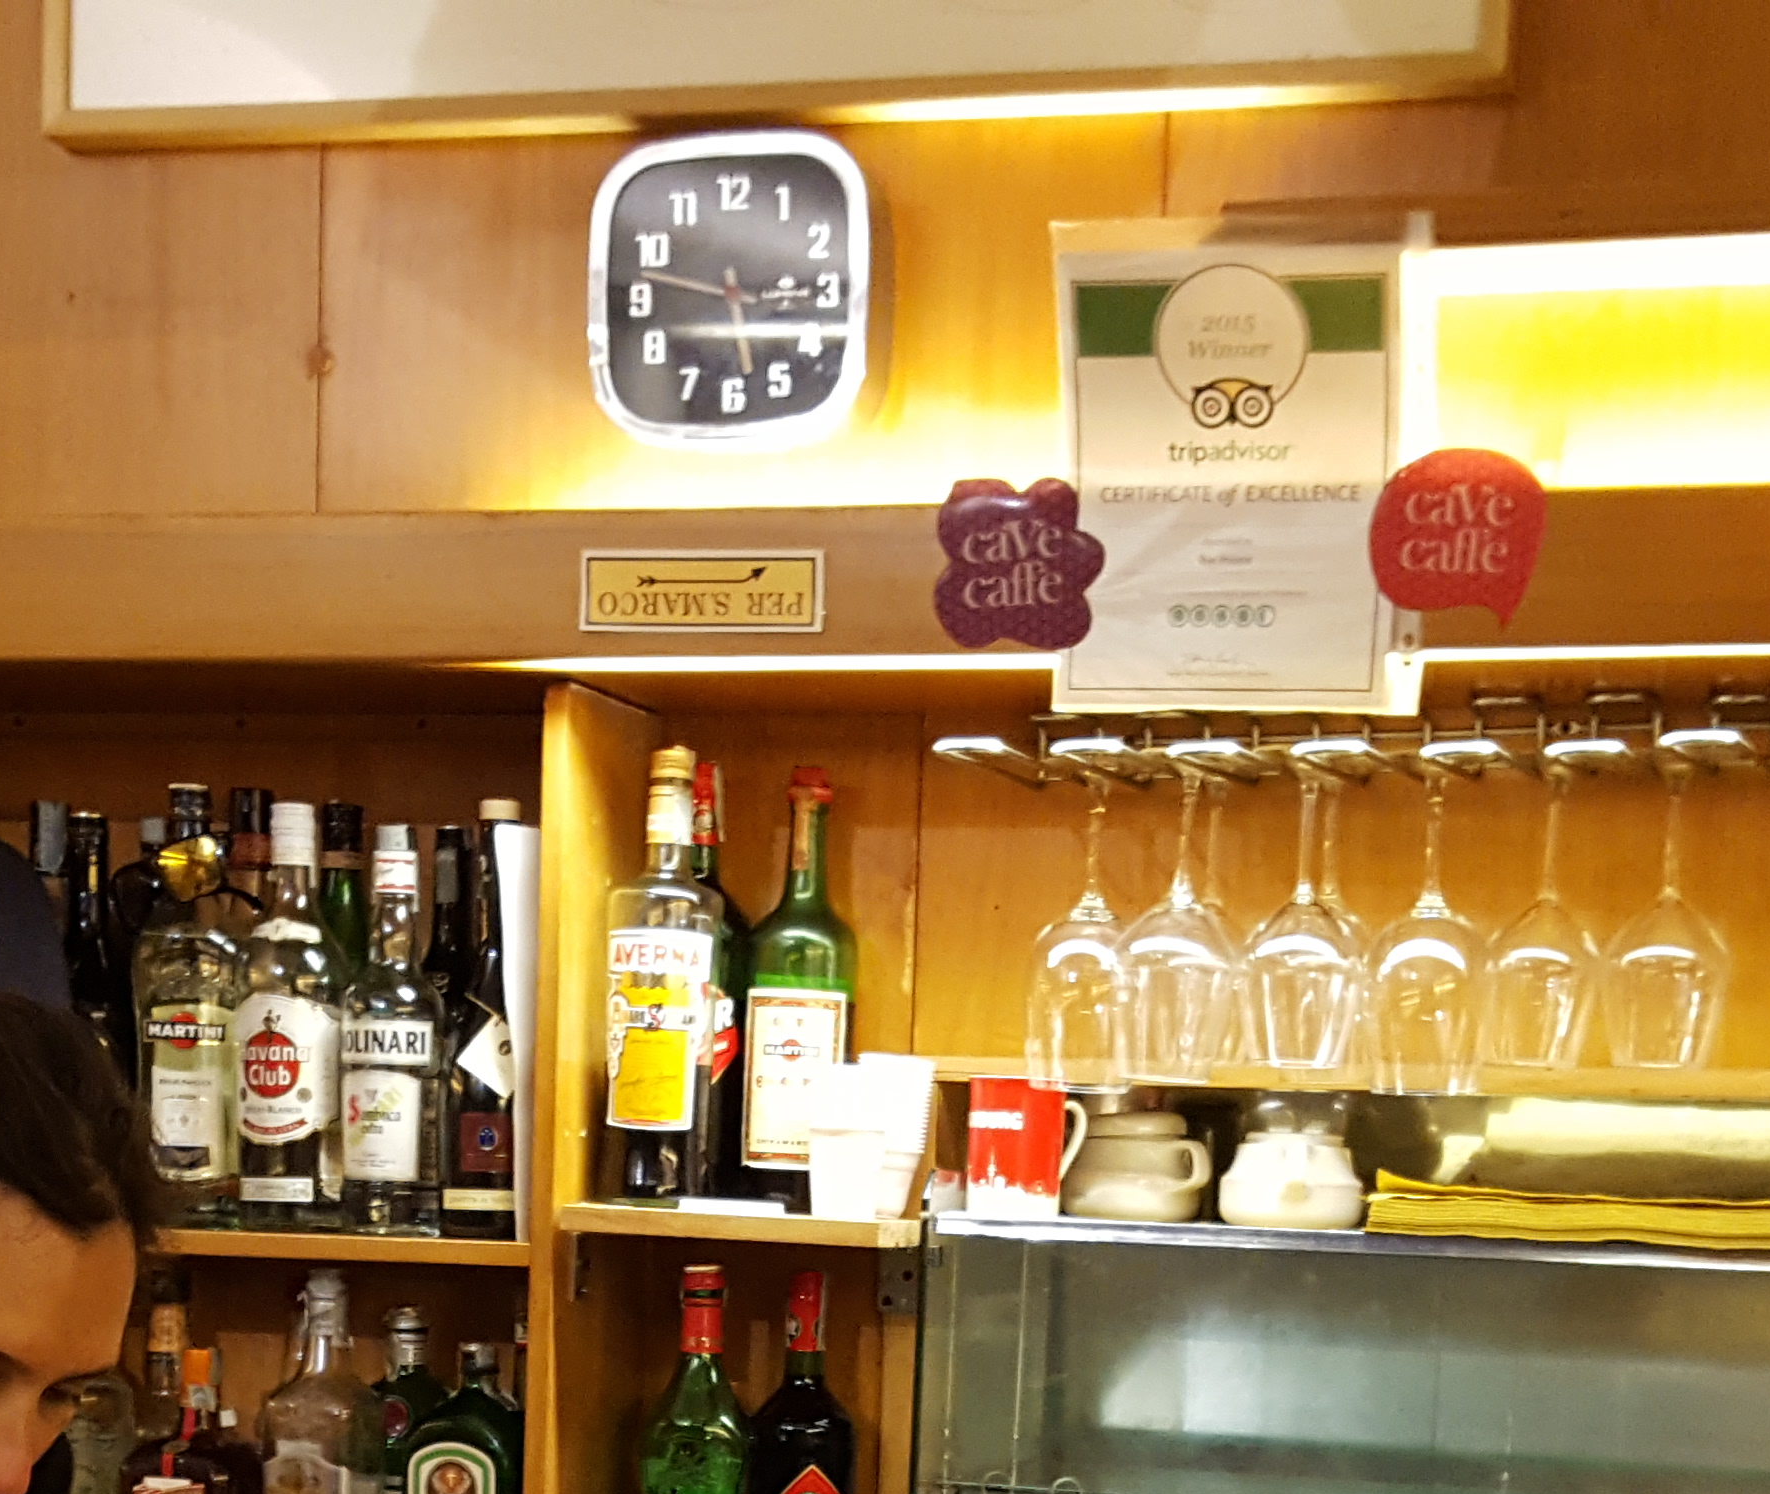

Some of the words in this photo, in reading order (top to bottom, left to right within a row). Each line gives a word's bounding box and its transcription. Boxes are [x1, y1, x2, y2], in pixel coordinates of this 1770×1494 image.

[670, 191, 698, 226] 11
[716, 174, 751, 210] 12
[775, 184, 793, 220] 1
[635, 233, 670, 267] 10
[808, 222, 831, 260] 2
[629, 282, 653, 318] 9
[816, 272, 840, 308] 3
[643, 330, 667, 365] 8
[798, 323, 822, 358] 4
[679, 367, 700, 401] 7
[721, 376, 746, 414] 6
[767, 362, 792, 398] 5
[1168, 440, 1291, 466] tripadvisor
[1100, 485, 1212, 502] CERTIFICATE
[1217, 484, 1240, 507] of
[1245, 485, 1360, 502] EXCELLENCE
[746, 592, 805, 617] PER
[147, 1022, 225, 1040] MARTINI
[249, 1066, 292, 1087] Club
